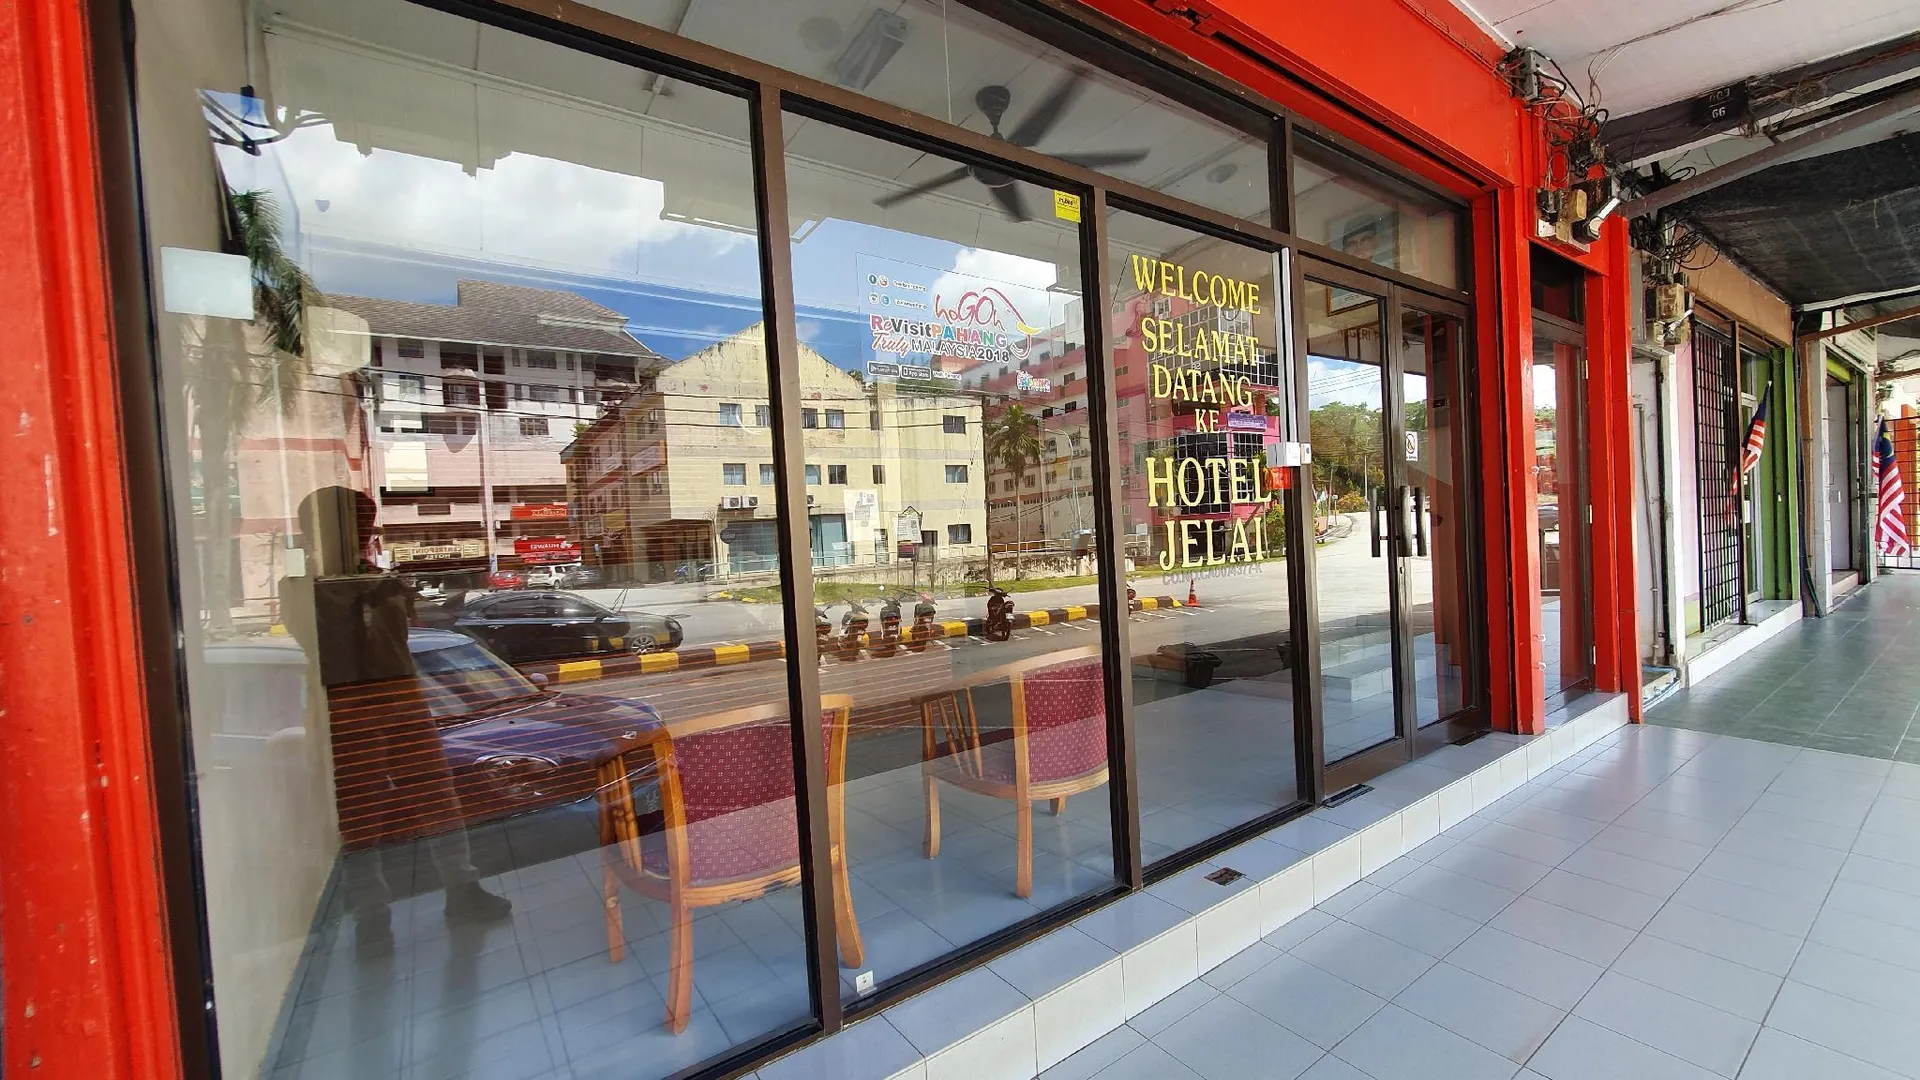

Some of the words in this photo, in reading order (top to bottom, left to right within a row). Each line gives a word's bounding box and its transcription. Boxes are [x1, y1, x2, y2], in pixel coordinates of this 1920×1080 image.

[1132, 254, 1261, 315] WELCOME
[873, 332, 909, 356] Truly
[1141, 317, 1259, 366] SELAMAT
[1152, 364, 1253, 407] DATANG
[1194, 408, 1221, 433] KE
[1145, 457, 1272, 507] HOTEL
[1159, 517, 1264, 571] JELAI
